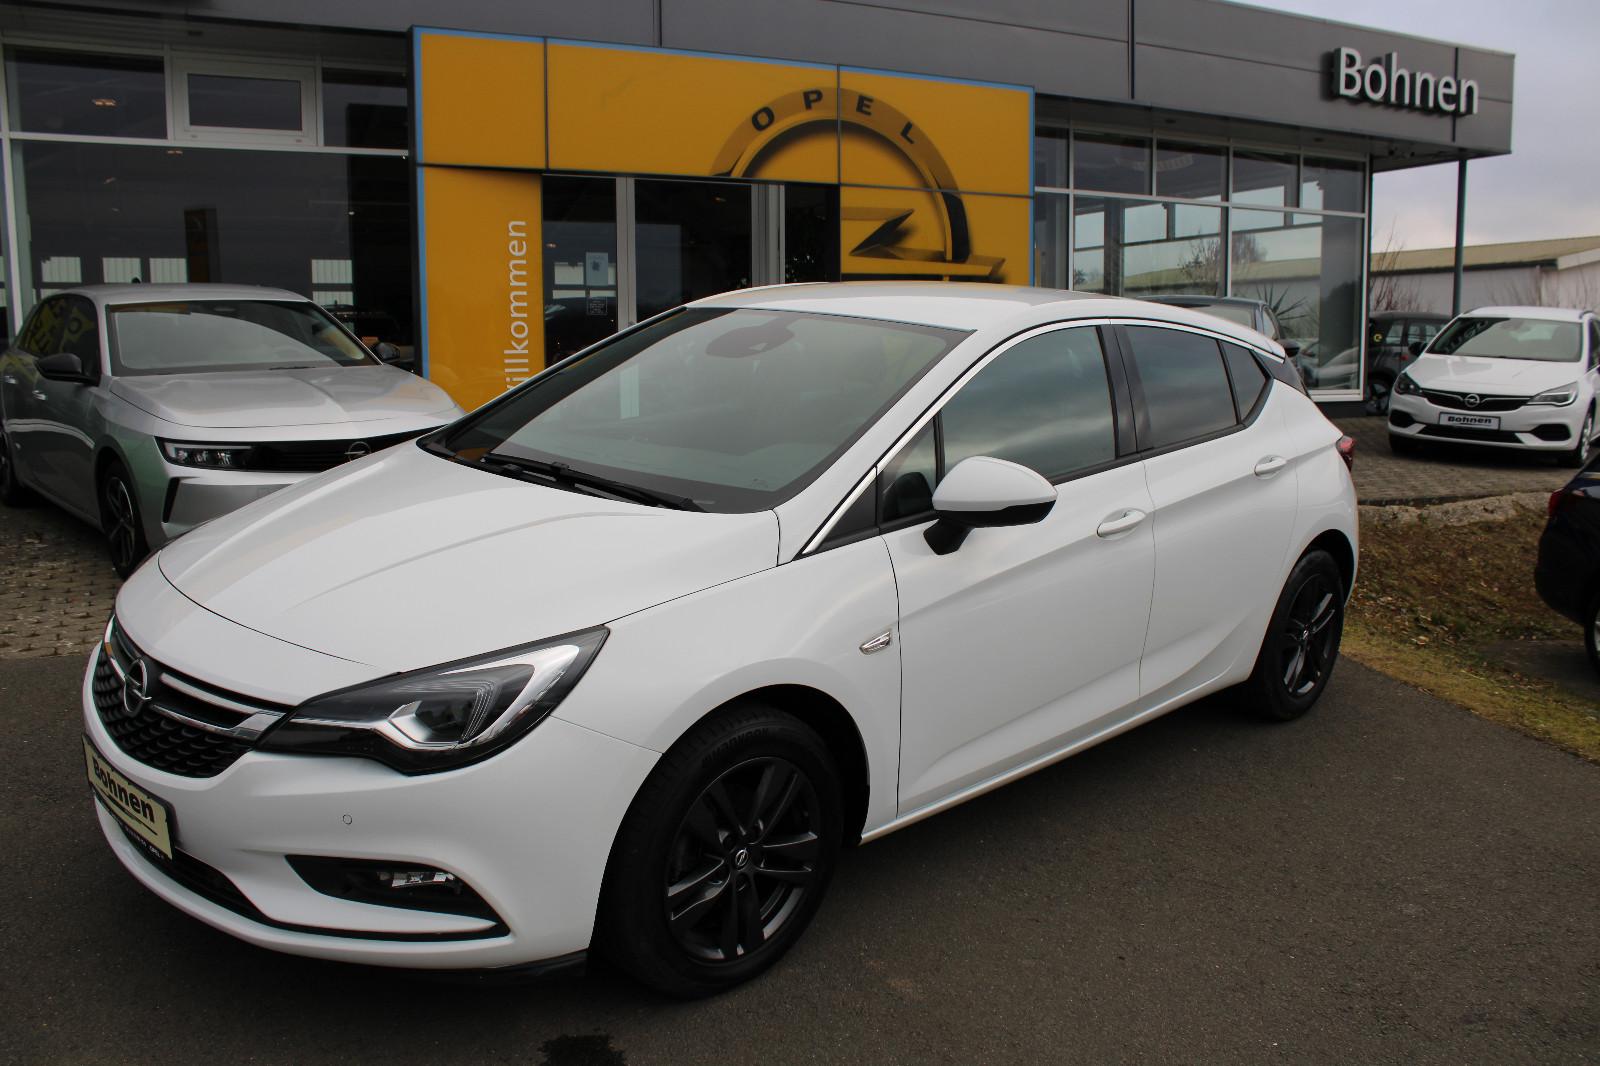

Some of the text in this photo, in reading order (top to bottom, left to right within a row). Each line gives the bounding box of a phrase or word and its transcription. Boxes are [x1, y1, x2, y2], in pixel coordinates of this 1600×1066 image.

[1339, 46, 1479, 115] Bohnen
[751, 88, 915, 145] OPEL
[503, 220, 529, 391] illkommen
[1447, 416, 1492, 424] Bohnen
[92, 755, 155, 824] Bohnen
